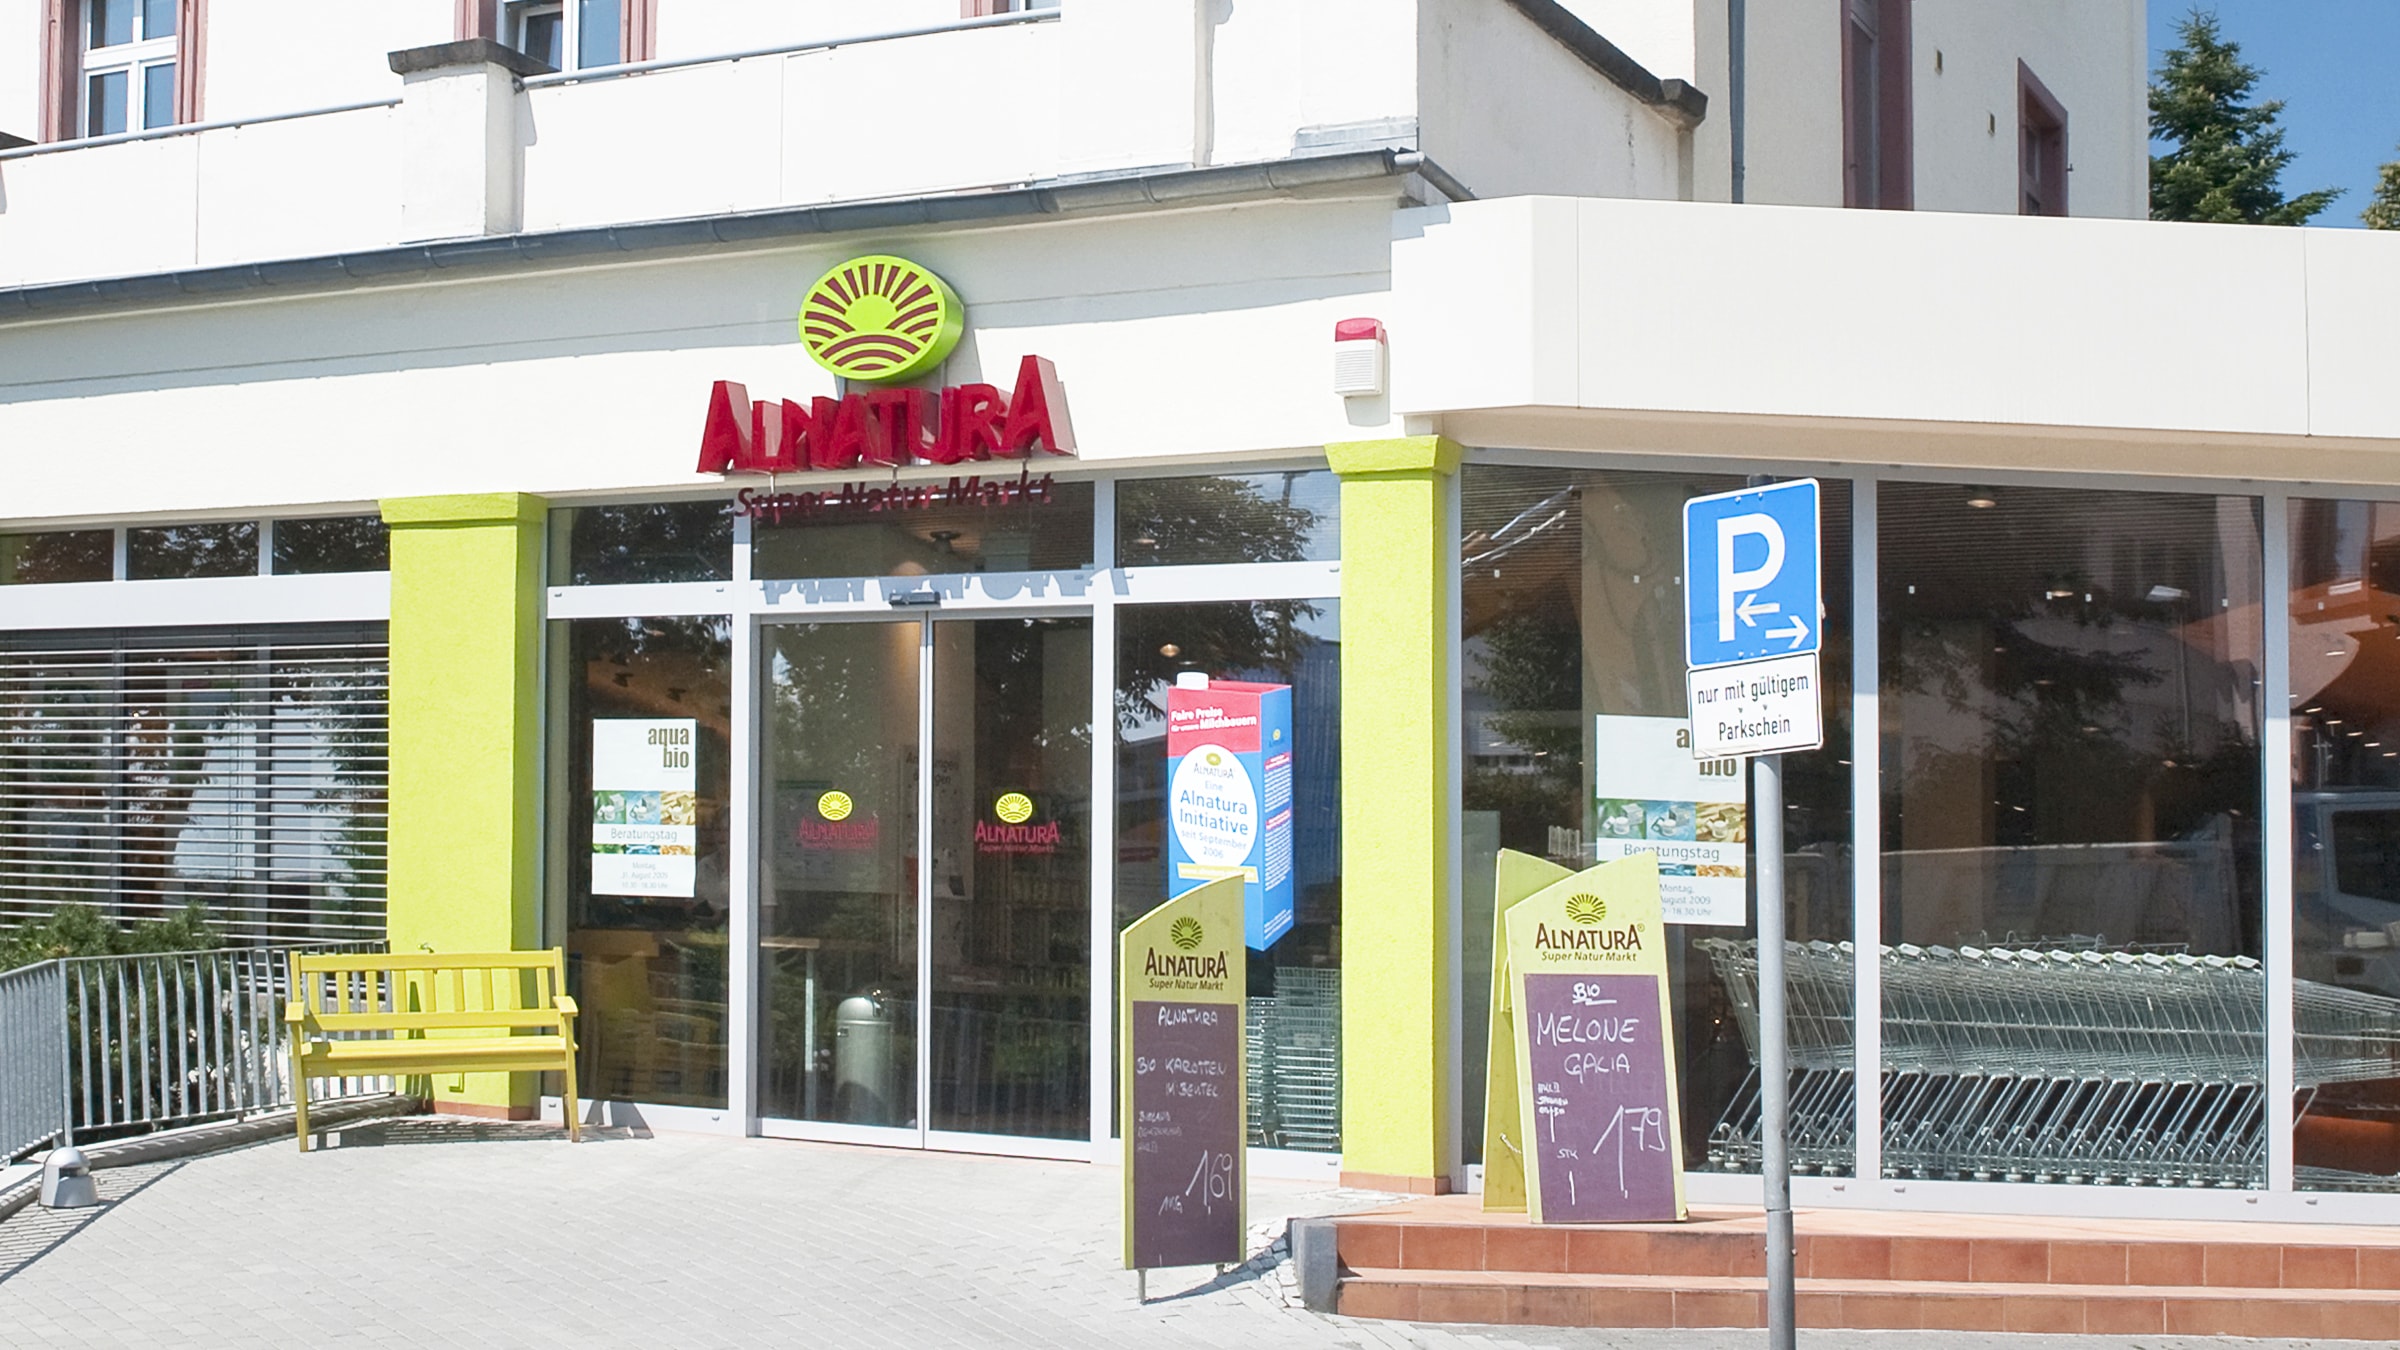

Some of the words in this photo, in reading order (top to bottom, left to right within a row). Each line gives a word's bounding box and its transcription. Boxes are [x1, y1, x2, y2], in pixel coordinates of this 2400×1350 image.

[697, 354, 1074, 473] ALNATURA
[736, 486, 833, 524] Super
[842, 481, 938, 512] Natur
[943, 469, 1056, 507] Markt
[1717, 513, 1785, 642] P
[1697, 687, 1719, 704] nur
[1725, 679, 1745, 699] mit
[1751, 673, 1809, 702] gültigem
[648, 728, 690, 750] aqua
[1718, 716, 1791, 741] Parkschein
[663, 748, 690, 768] bio
[1194, 762, 1234, 779] ALNATURA
[1204, 780, 1224, 792] Eine
[1180, 790, 1248, 815] Alnatura
[975, 820, 1060, 843] ALNATURA
[1179, 808, 1248, 836] Initiative
[610, 828, 678, 842] Beratungstag
[1199, 832, 1247, 850] September
[1203, 846, 1224, 859] 2006
[1144, 947, 1228, 979] ALNATURA
[1542, 951, 1572, 963] Super
[1574, 952, 1604, 961] Natur
[1606, 952, 1637, 961] Markt
[1149, 978, 1173, 991] Super
[1175, 980, 1199, 989] Natur
[1200, 980, 1223, 991] Markt
[1536, 1012, 1640, 1047] MELONE
[1165, 1057, 1227, 1076] KAROTTEN
[1564, 1053, 1631, 1084] GALIA
